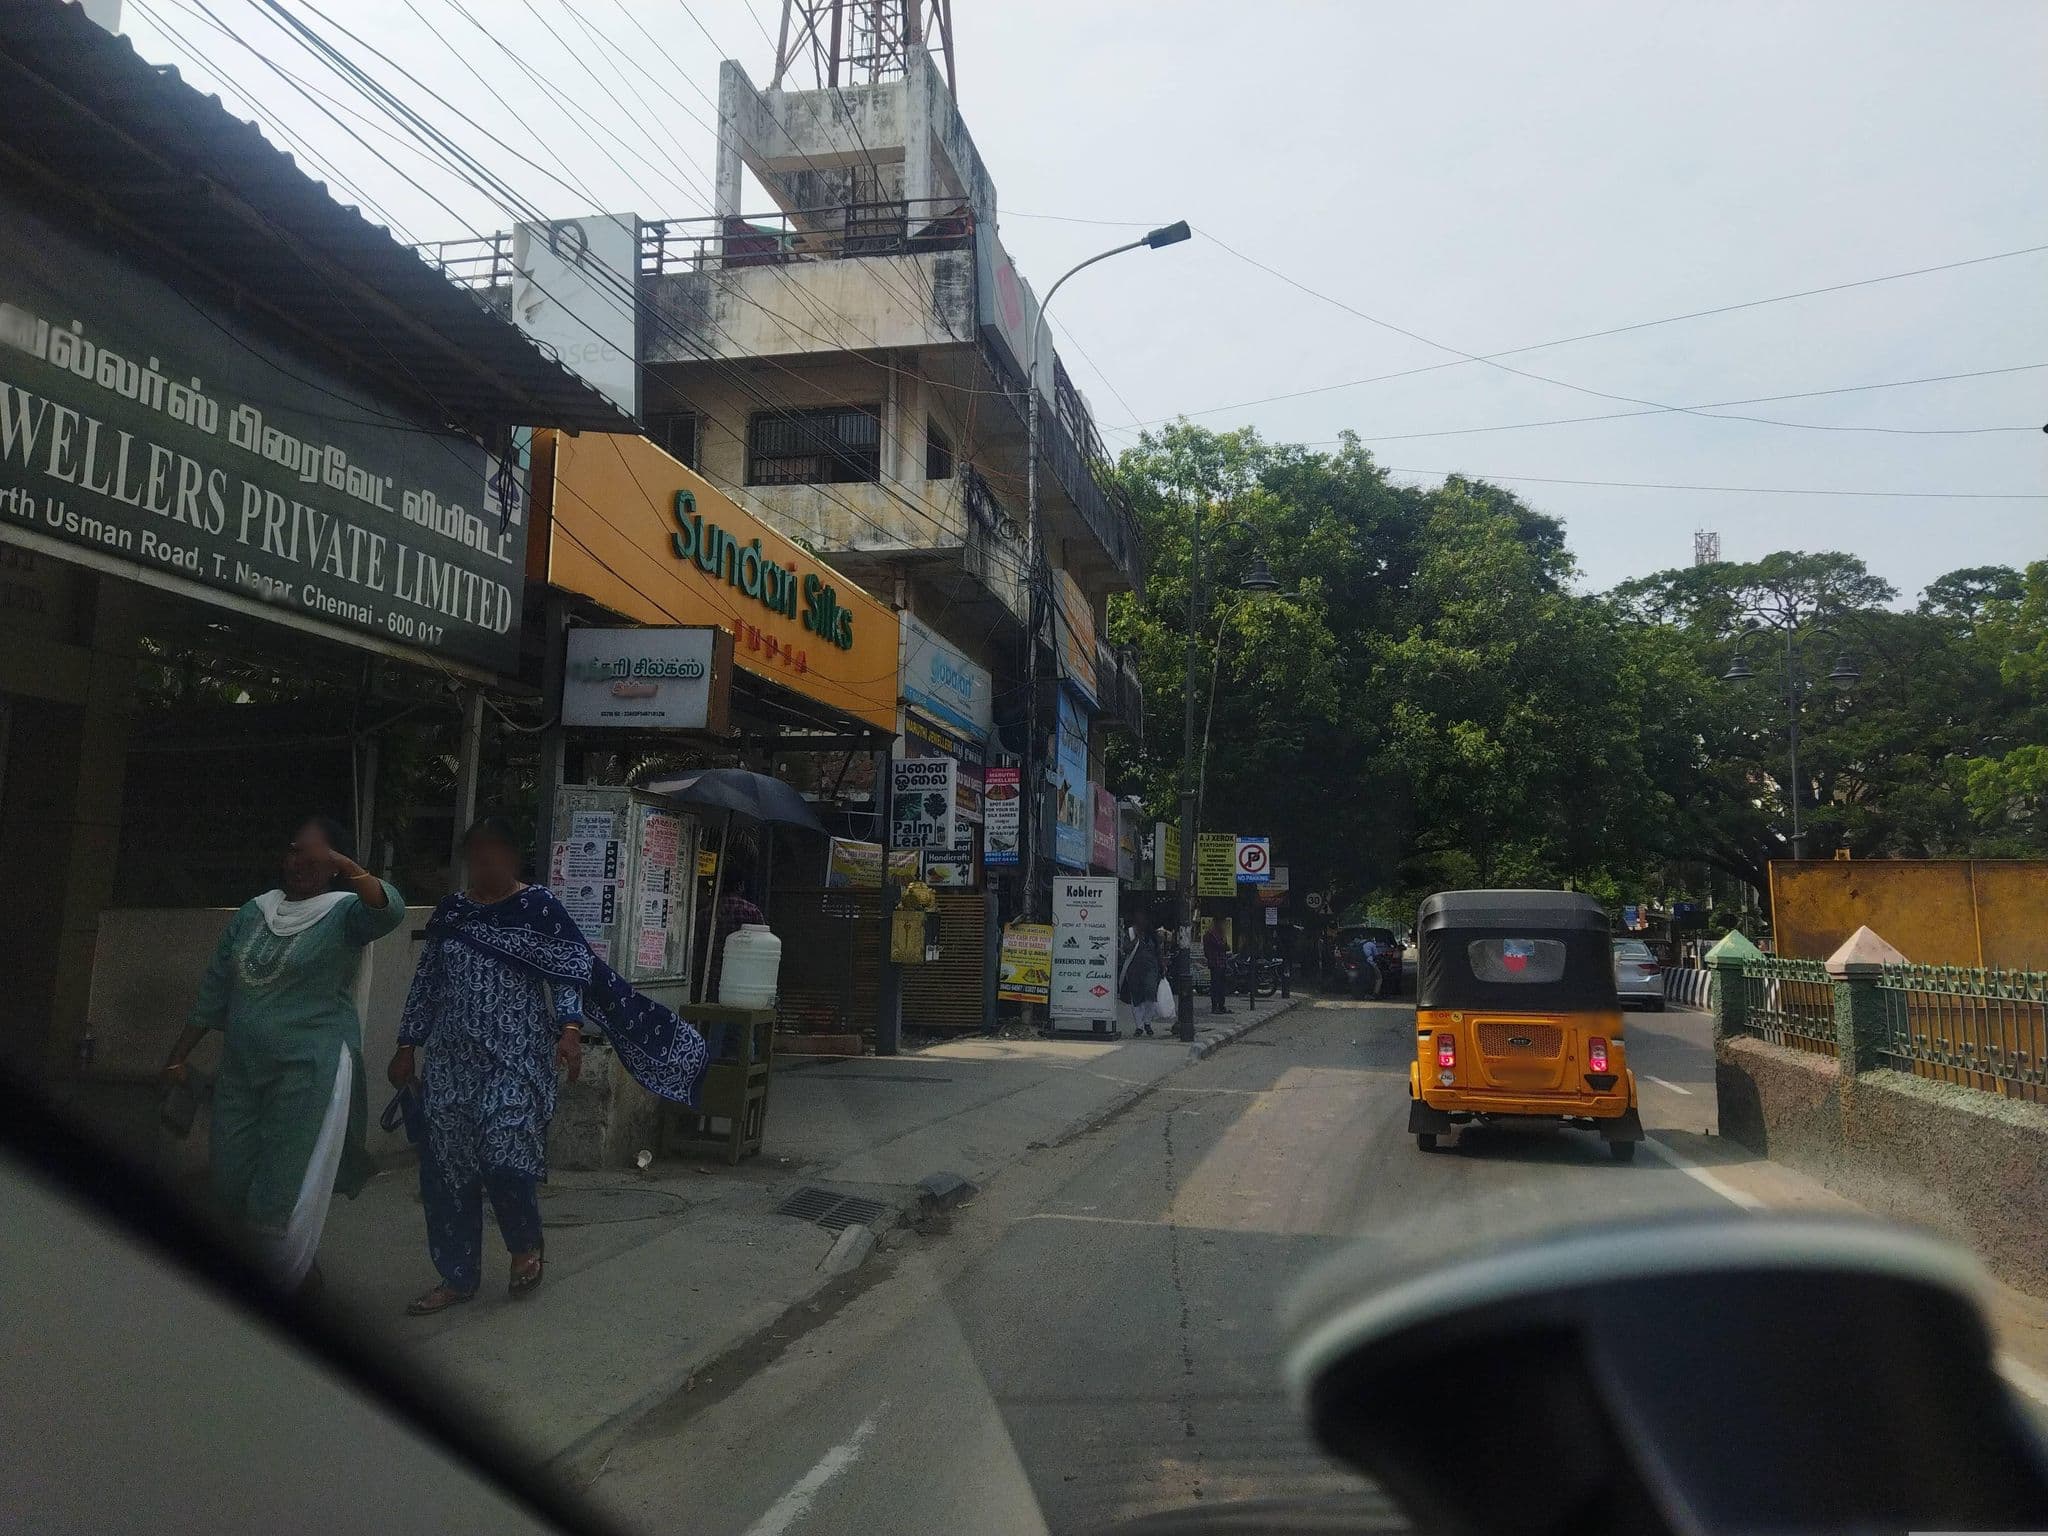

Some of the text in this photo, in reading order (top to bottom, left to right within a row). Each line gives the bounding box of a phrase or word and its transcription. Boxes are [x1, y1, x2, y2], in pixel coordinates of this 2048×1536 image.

[229, 403, 394, 513] பிரைவேட்
[402, 489, 513, 564] லிமிடெட்
[0, 380, 512, 634] WELLERS PRIVATE LIMITED
[46, 497, 132, 549] Usman
[141, 529, 203, 576] Road,
[212, 552, 227, 579] T.
[302, 584, 373, 625] Chennai
[388, 611, 413, 637] 600
[418, 621, 444, 643] 017
[672, 489, 853, 650] Sundari Silks
[895, 762, 948, 774] பனை
[894, 774, 947, 791] ஓலை
[893, 821, 933, 834] Palm
[893, 835, 928, 848] Leaf
[929, 852, 971, 862] Handicrafts
[1066, 885, 1103, 898] Koblerr
[1308, 896, 1320, 905] 30
